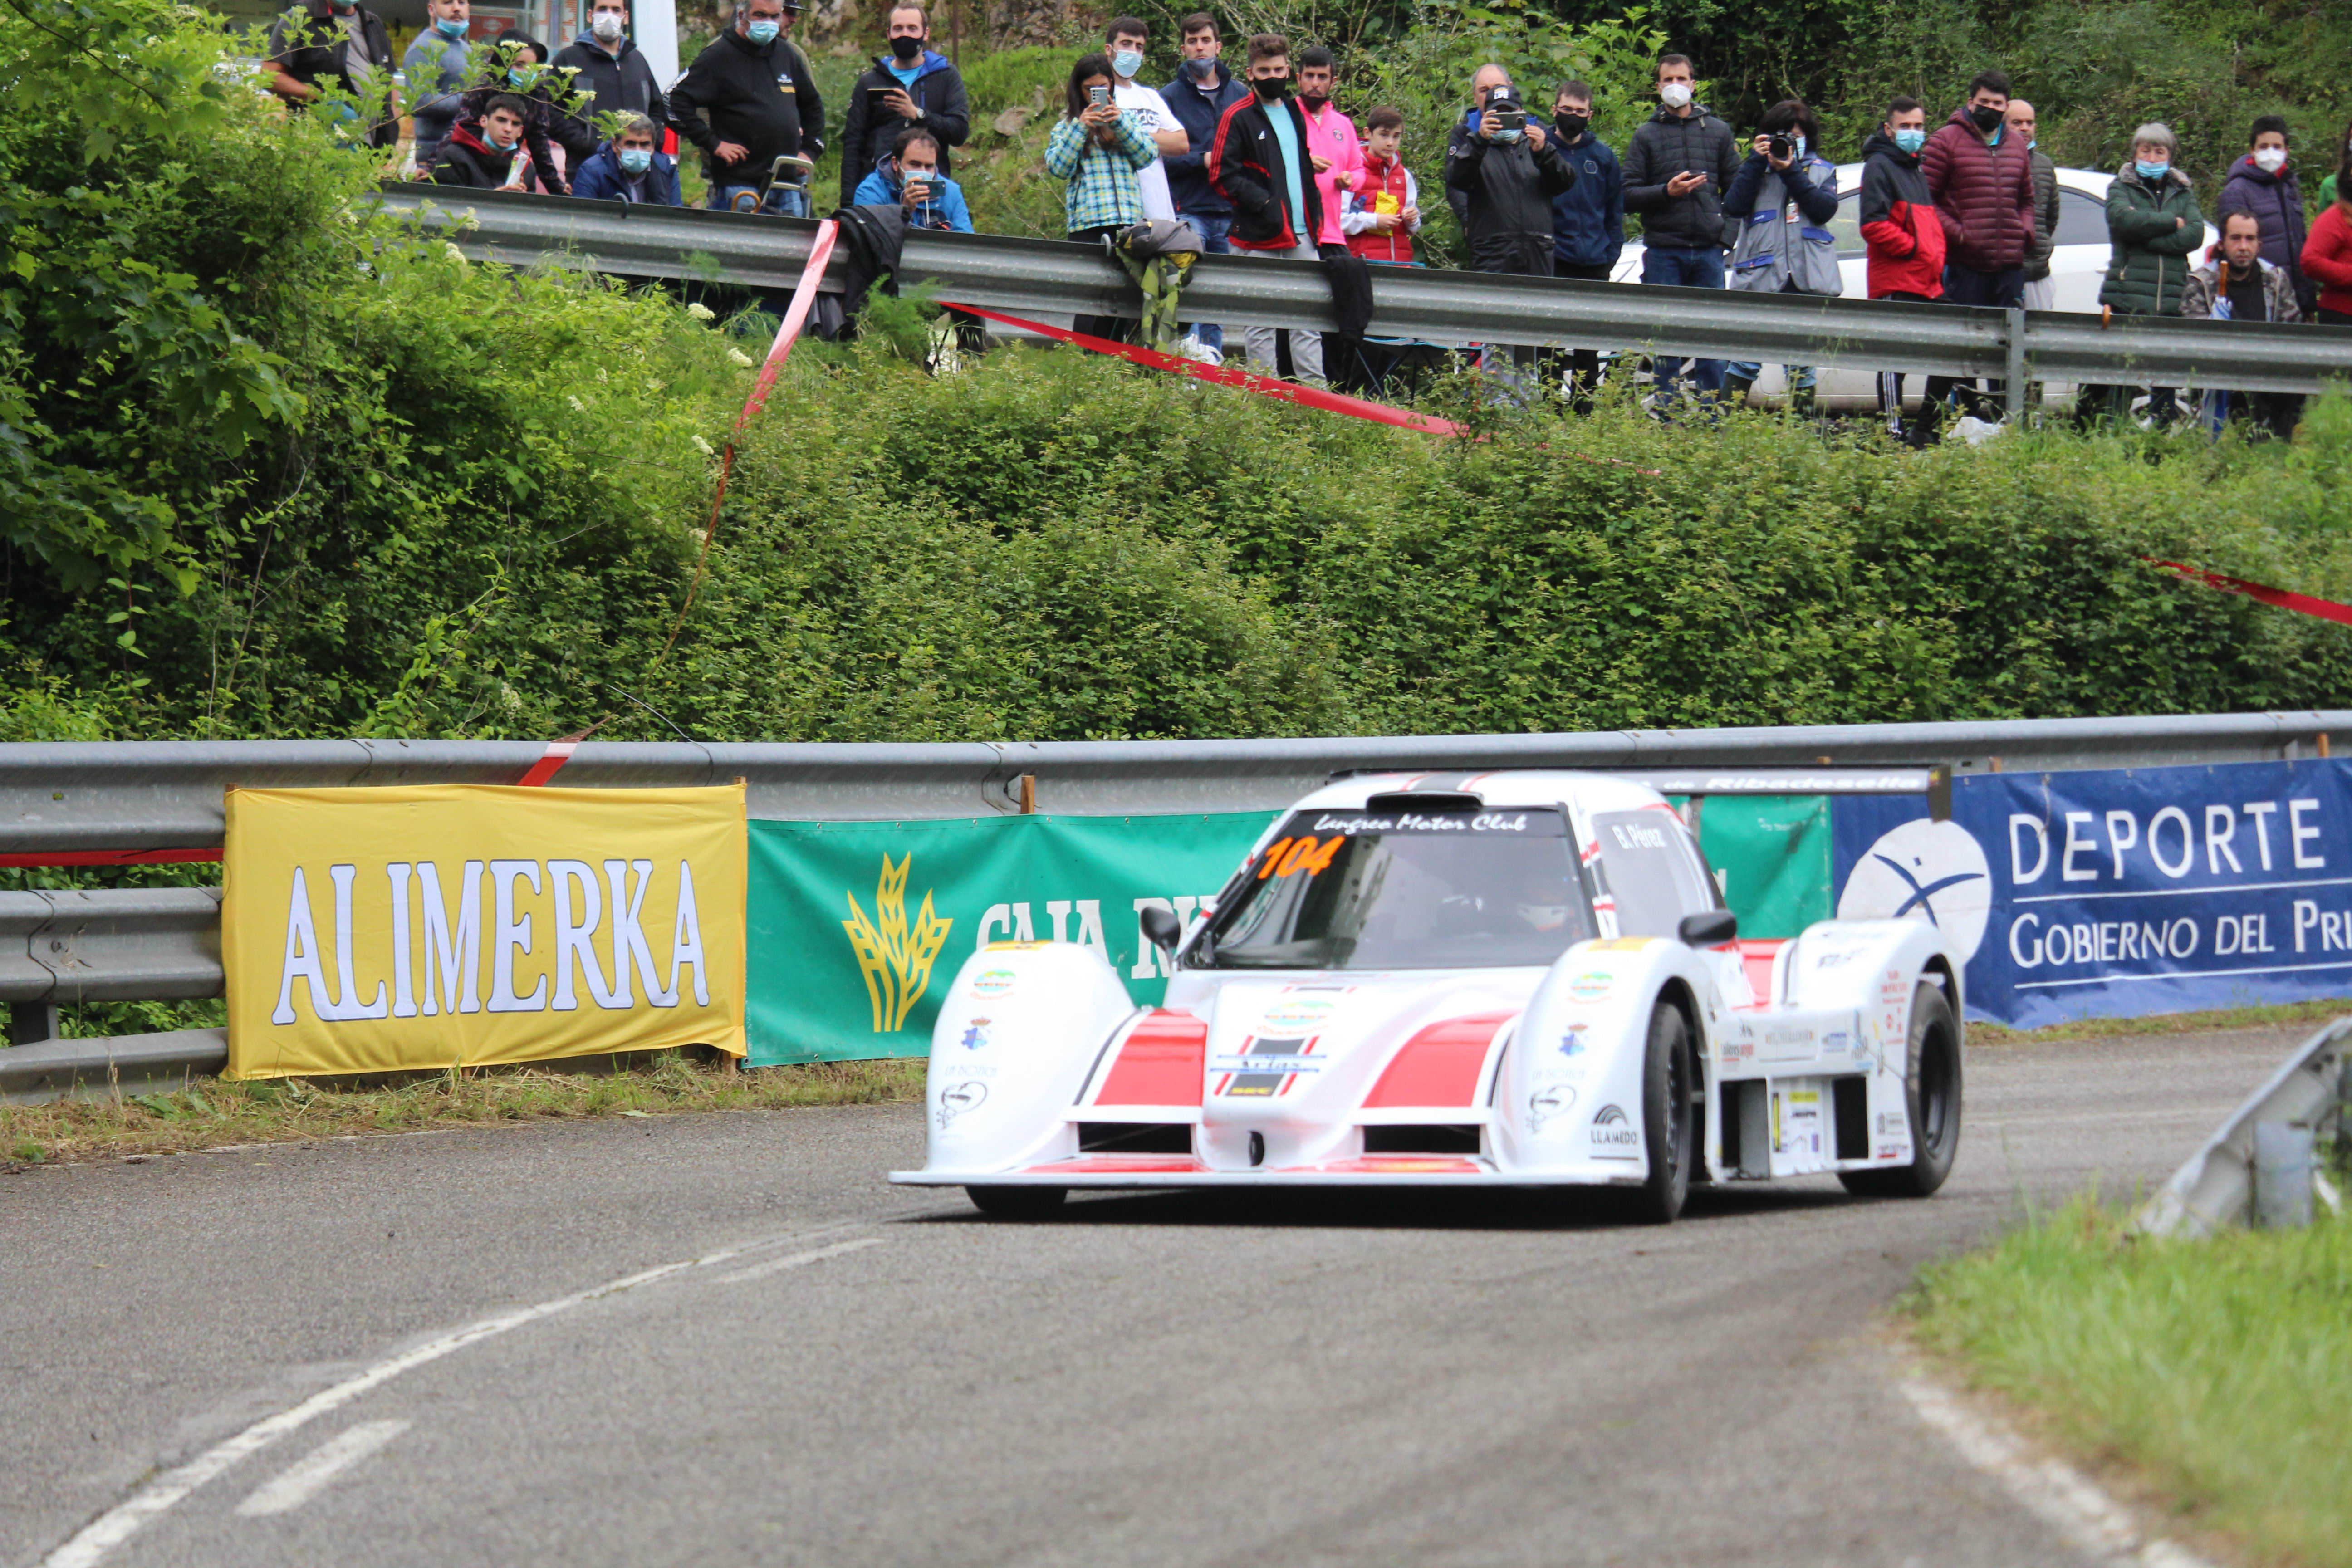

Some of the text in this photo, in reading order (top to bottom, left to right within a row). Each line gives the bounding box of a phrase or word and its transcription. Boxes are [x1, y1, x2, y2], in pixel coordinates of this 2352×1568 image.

[1313, 813, 1528, 835] Langreo Motor Club
[2009, 798, 2326, 885] DEPORTE
[1258, 835, 1346, 880] 104
[271, 858, 710, 1026] ALIMERKA
[2009, 912, 2199, 969] GOBIERNO
[2215, 912, 2274, 956] DEL
[1590, 1130, 1637, 1144] LLAMEDO
